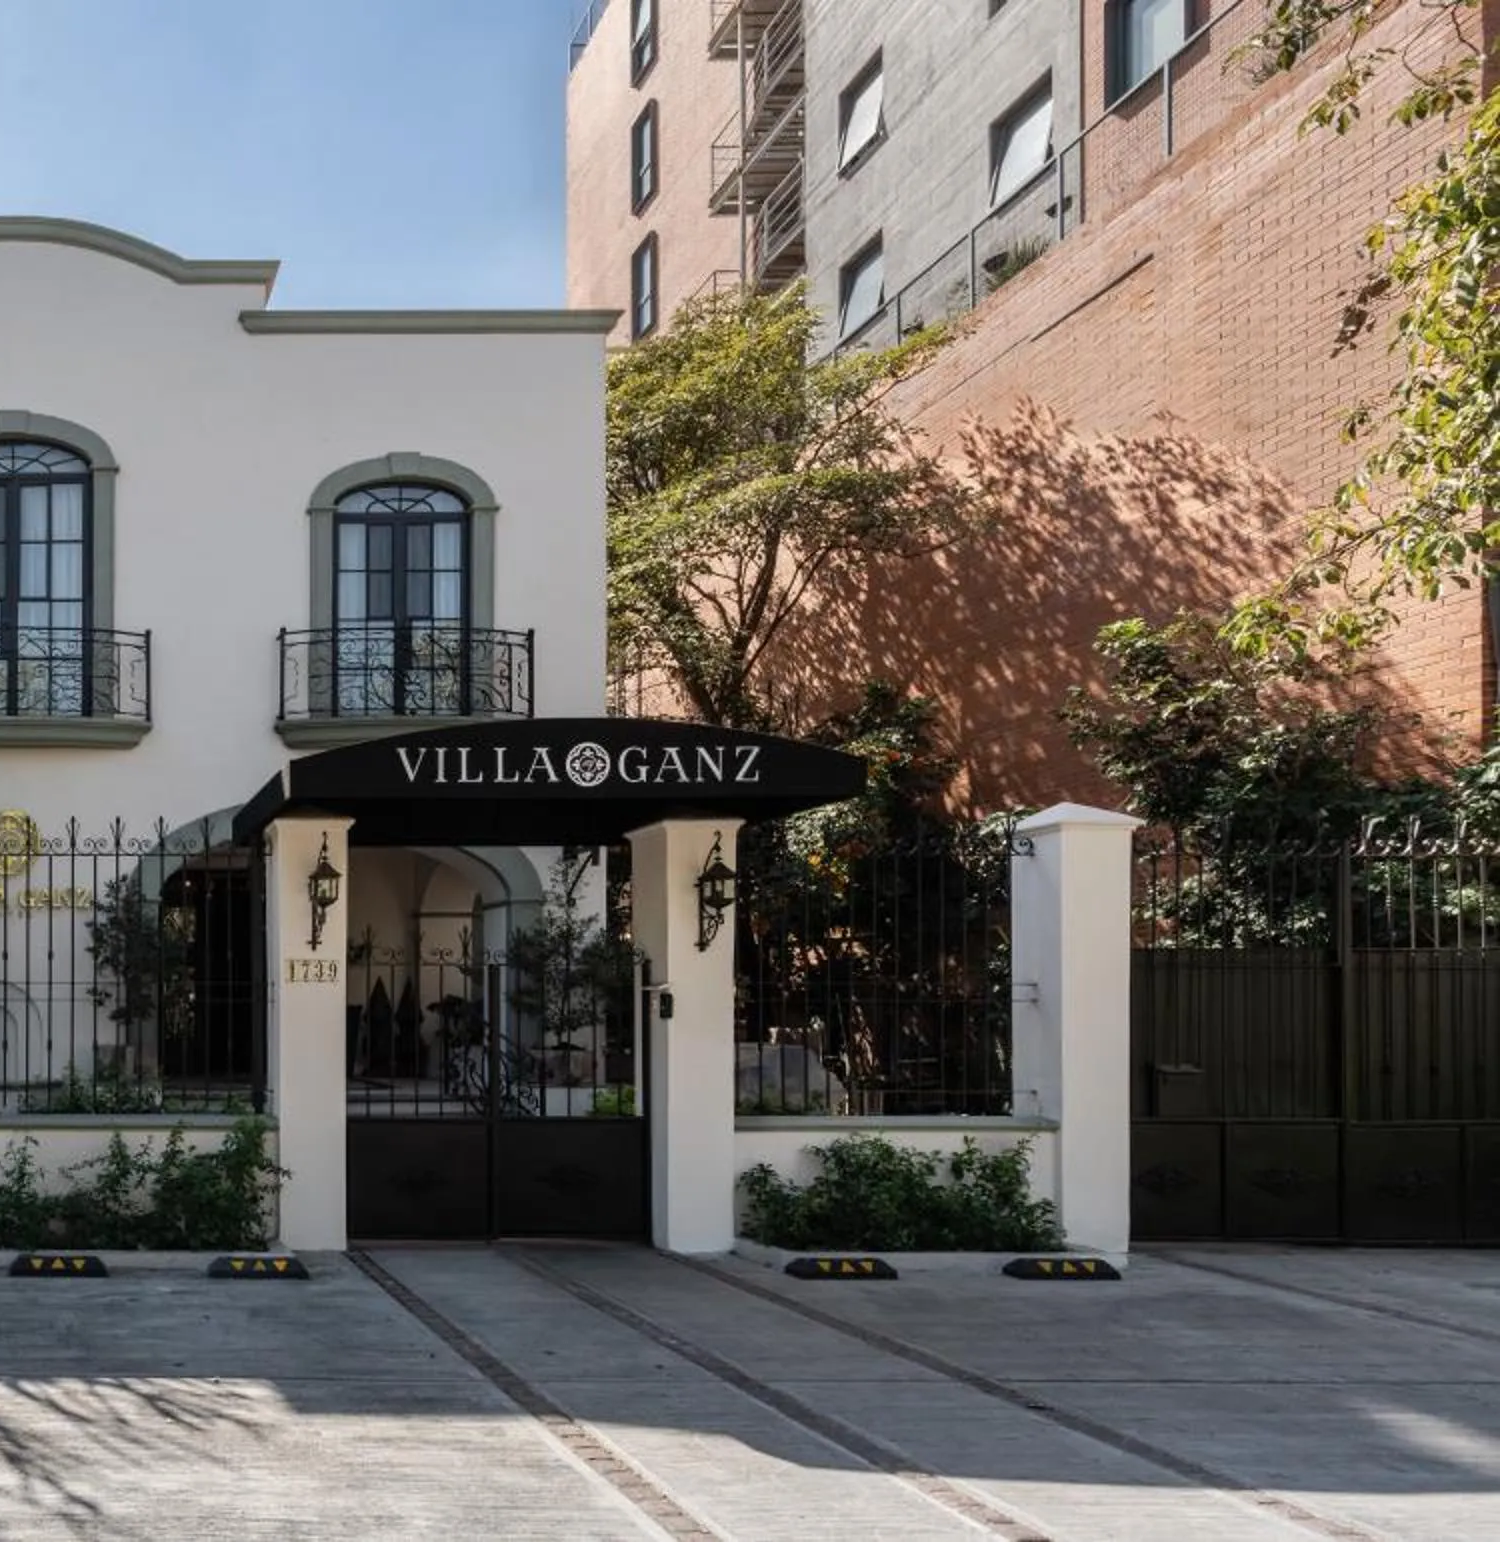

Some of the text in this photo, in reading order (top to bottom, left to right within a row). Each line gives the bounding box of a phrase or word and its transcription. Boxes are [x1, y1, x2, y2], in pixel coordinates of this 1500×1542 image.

[396, 745, 761, 783] VILLA GANZ
[288, 959, 338, 982] 1739
